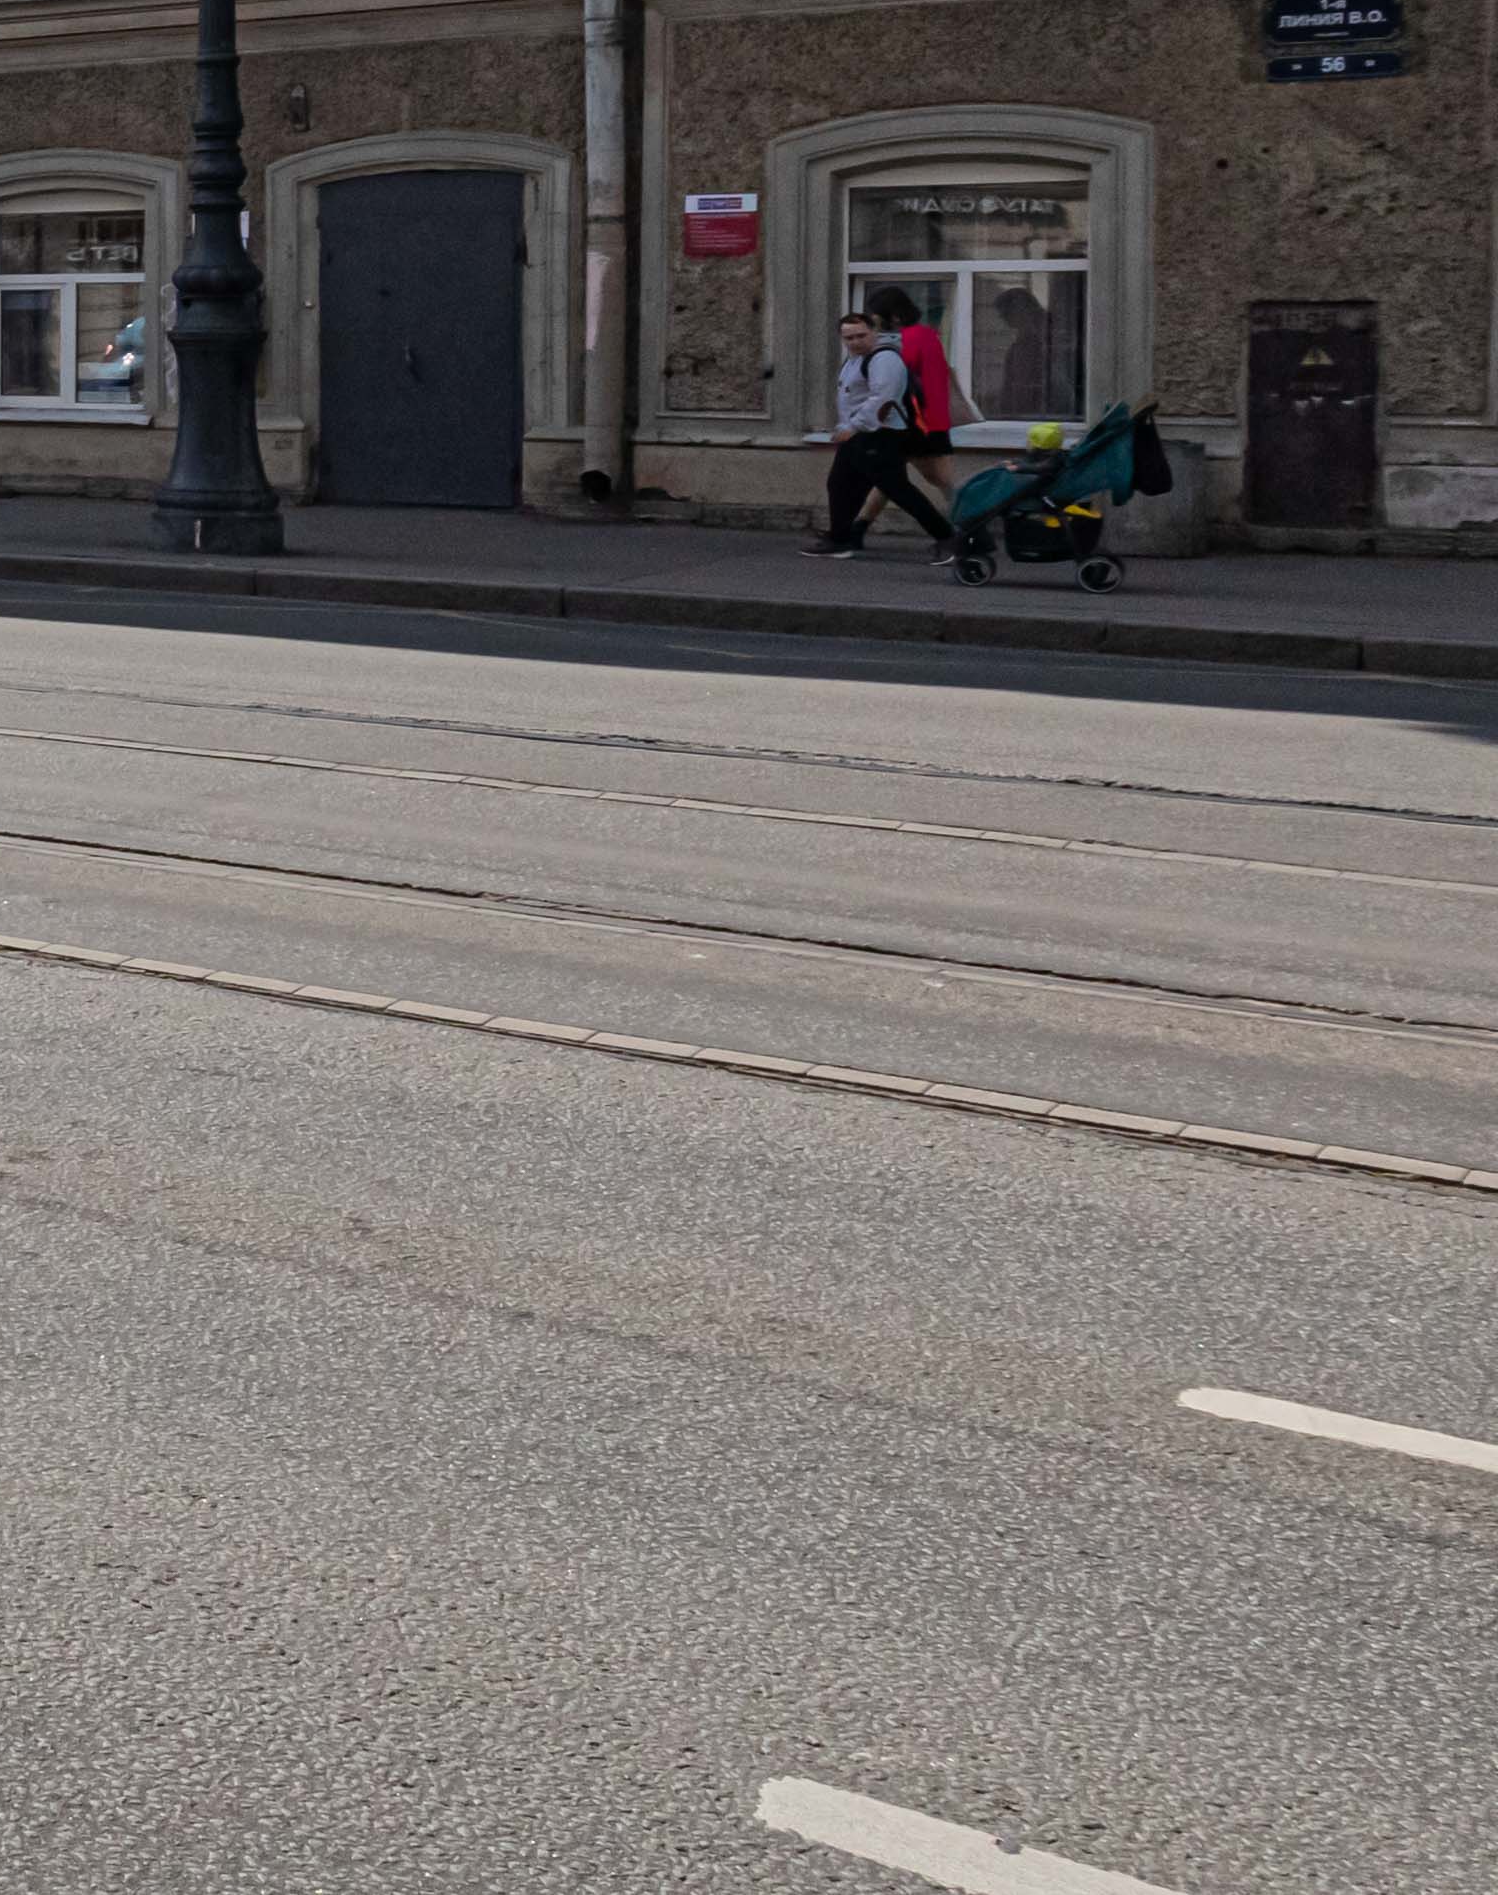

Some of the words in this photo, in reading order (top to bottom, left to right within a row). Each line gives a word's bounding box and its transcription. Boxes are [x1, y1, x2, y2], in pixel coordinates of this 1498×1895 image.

[1278, 12, 1344, 29] ЛИНИЯ
[1348, 10, 1387, 25] В.О.
[1321, 57, 1346, 73] 56
